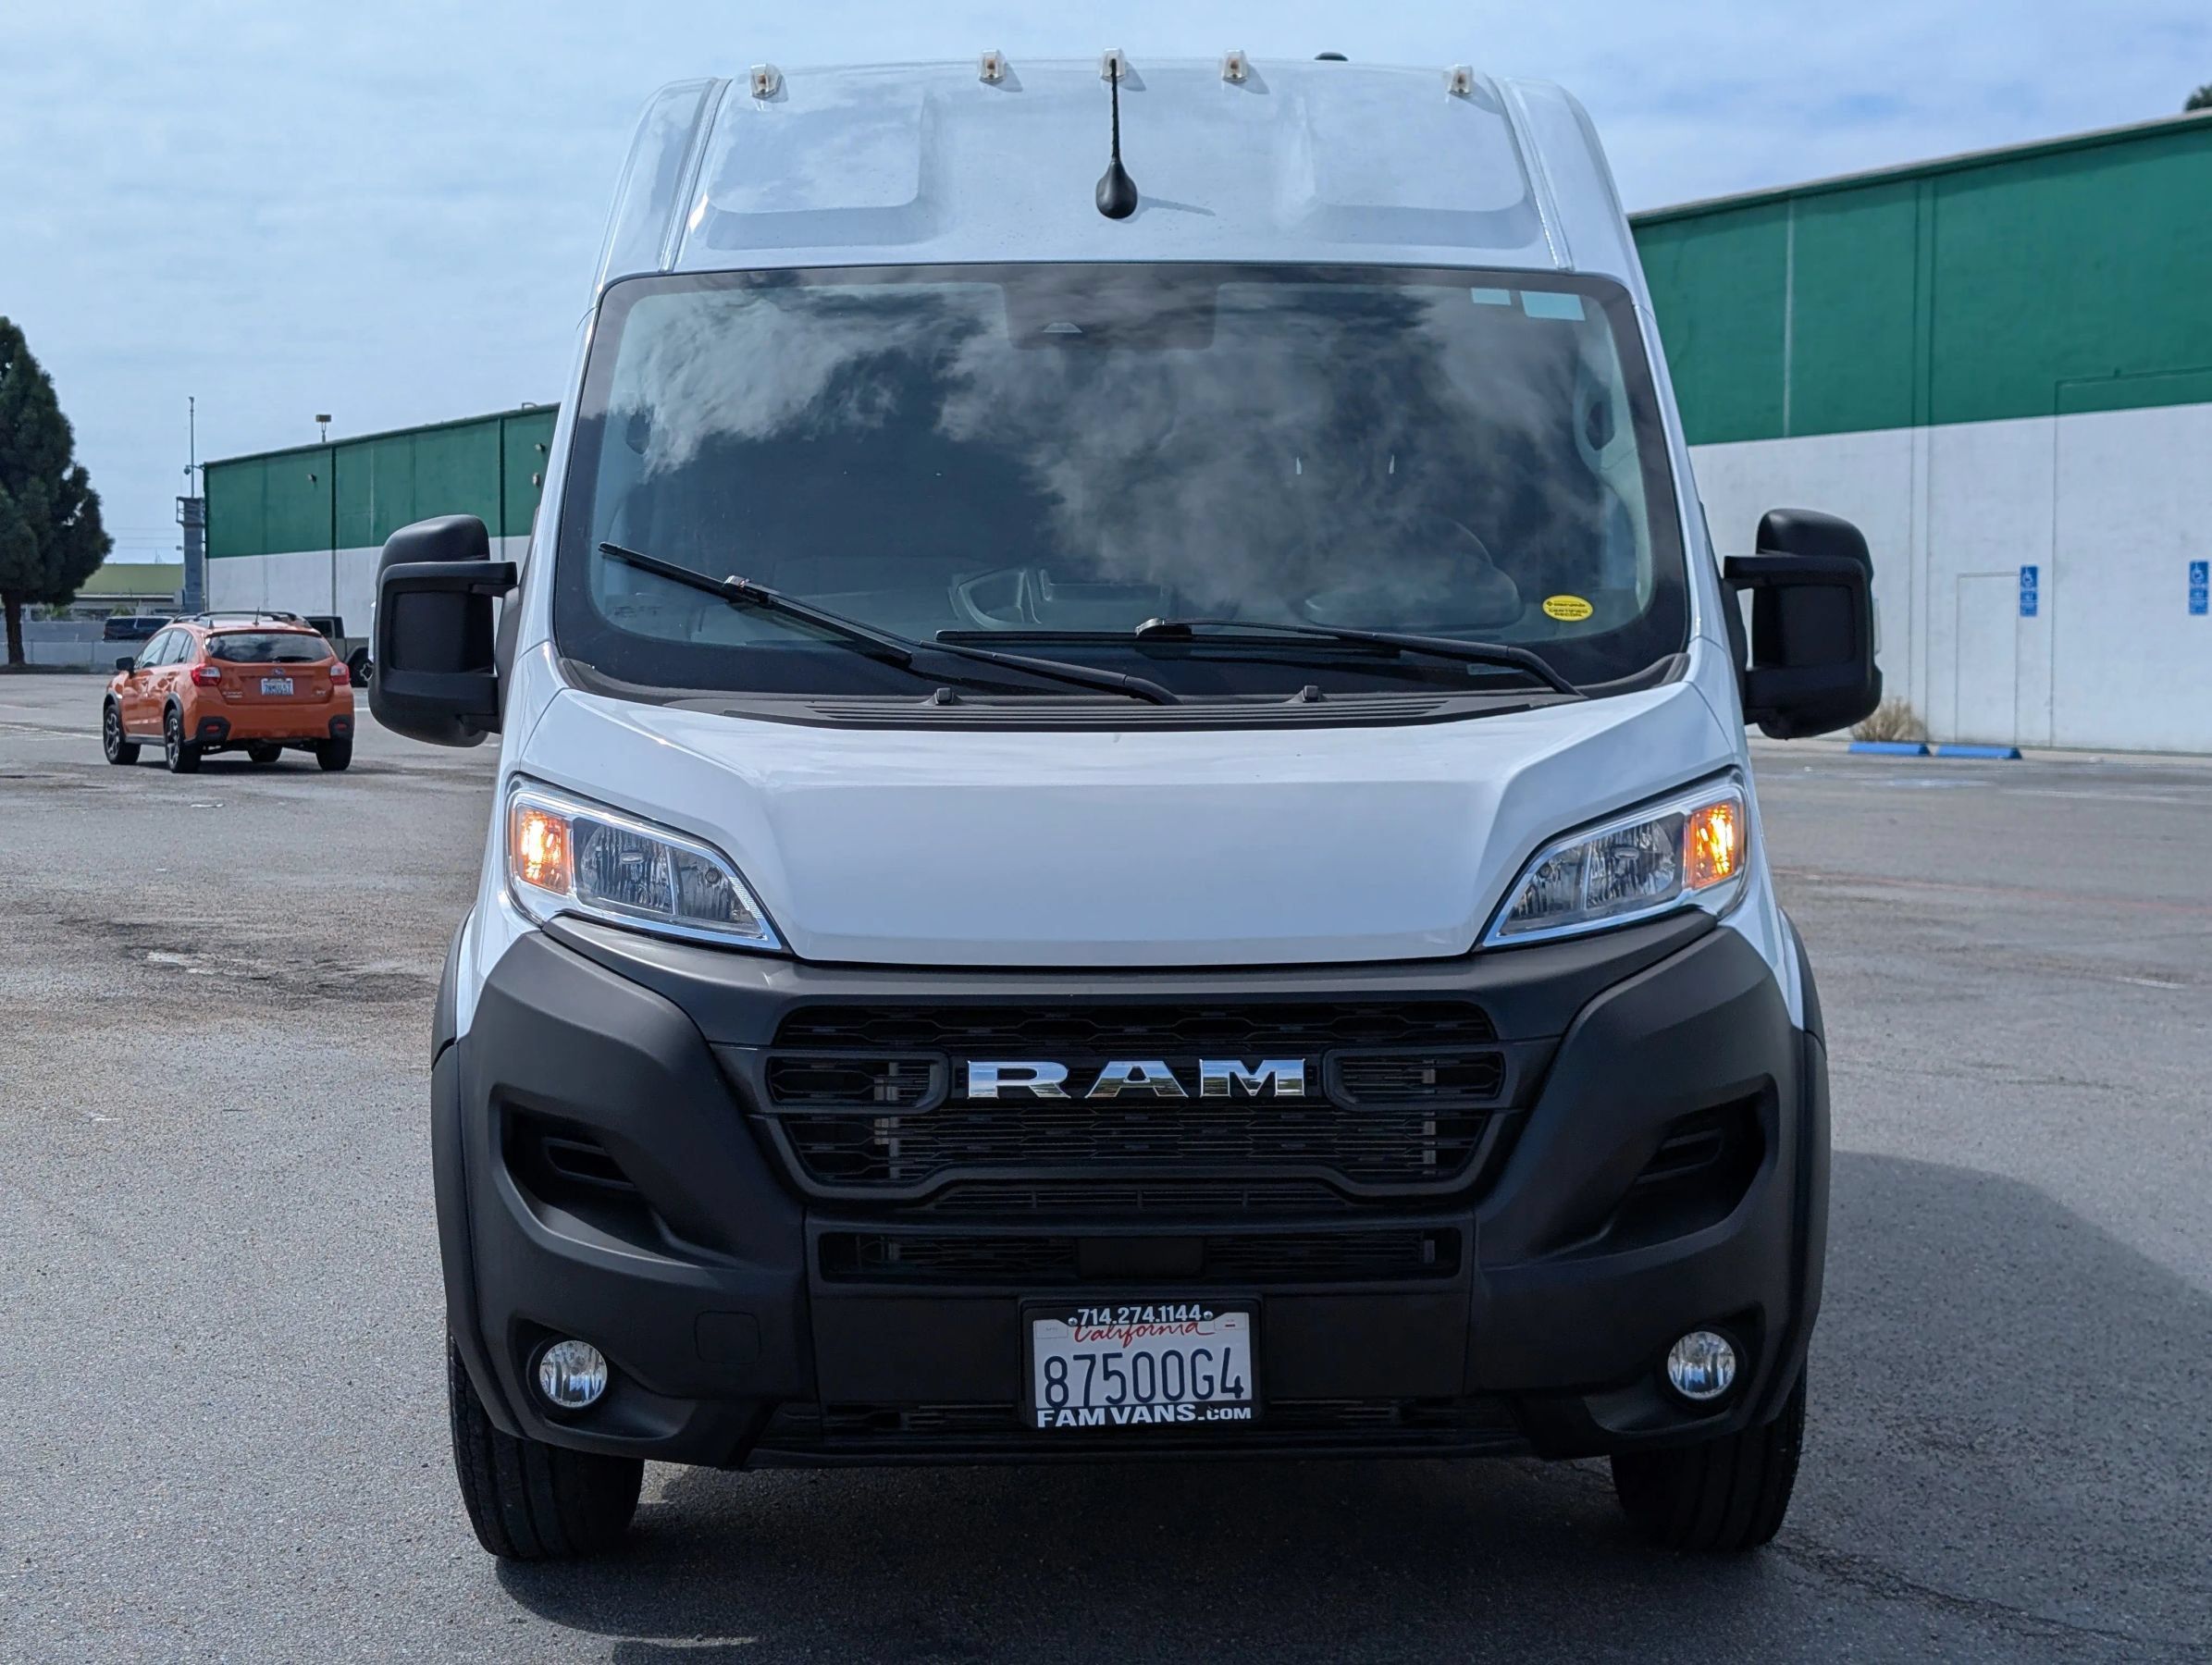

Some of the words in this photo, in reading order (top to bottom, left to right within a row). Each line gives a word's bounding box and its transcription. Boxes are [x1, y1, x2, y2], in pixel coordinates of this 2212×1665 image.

[968, 1058, 1305, 1099] RAM
[1077, 1304, 1202, 1326] 714.274.1144
[1073, 1321, 1216, 1348] California
[1044, 1347, 1244, 1408] 87500G4
